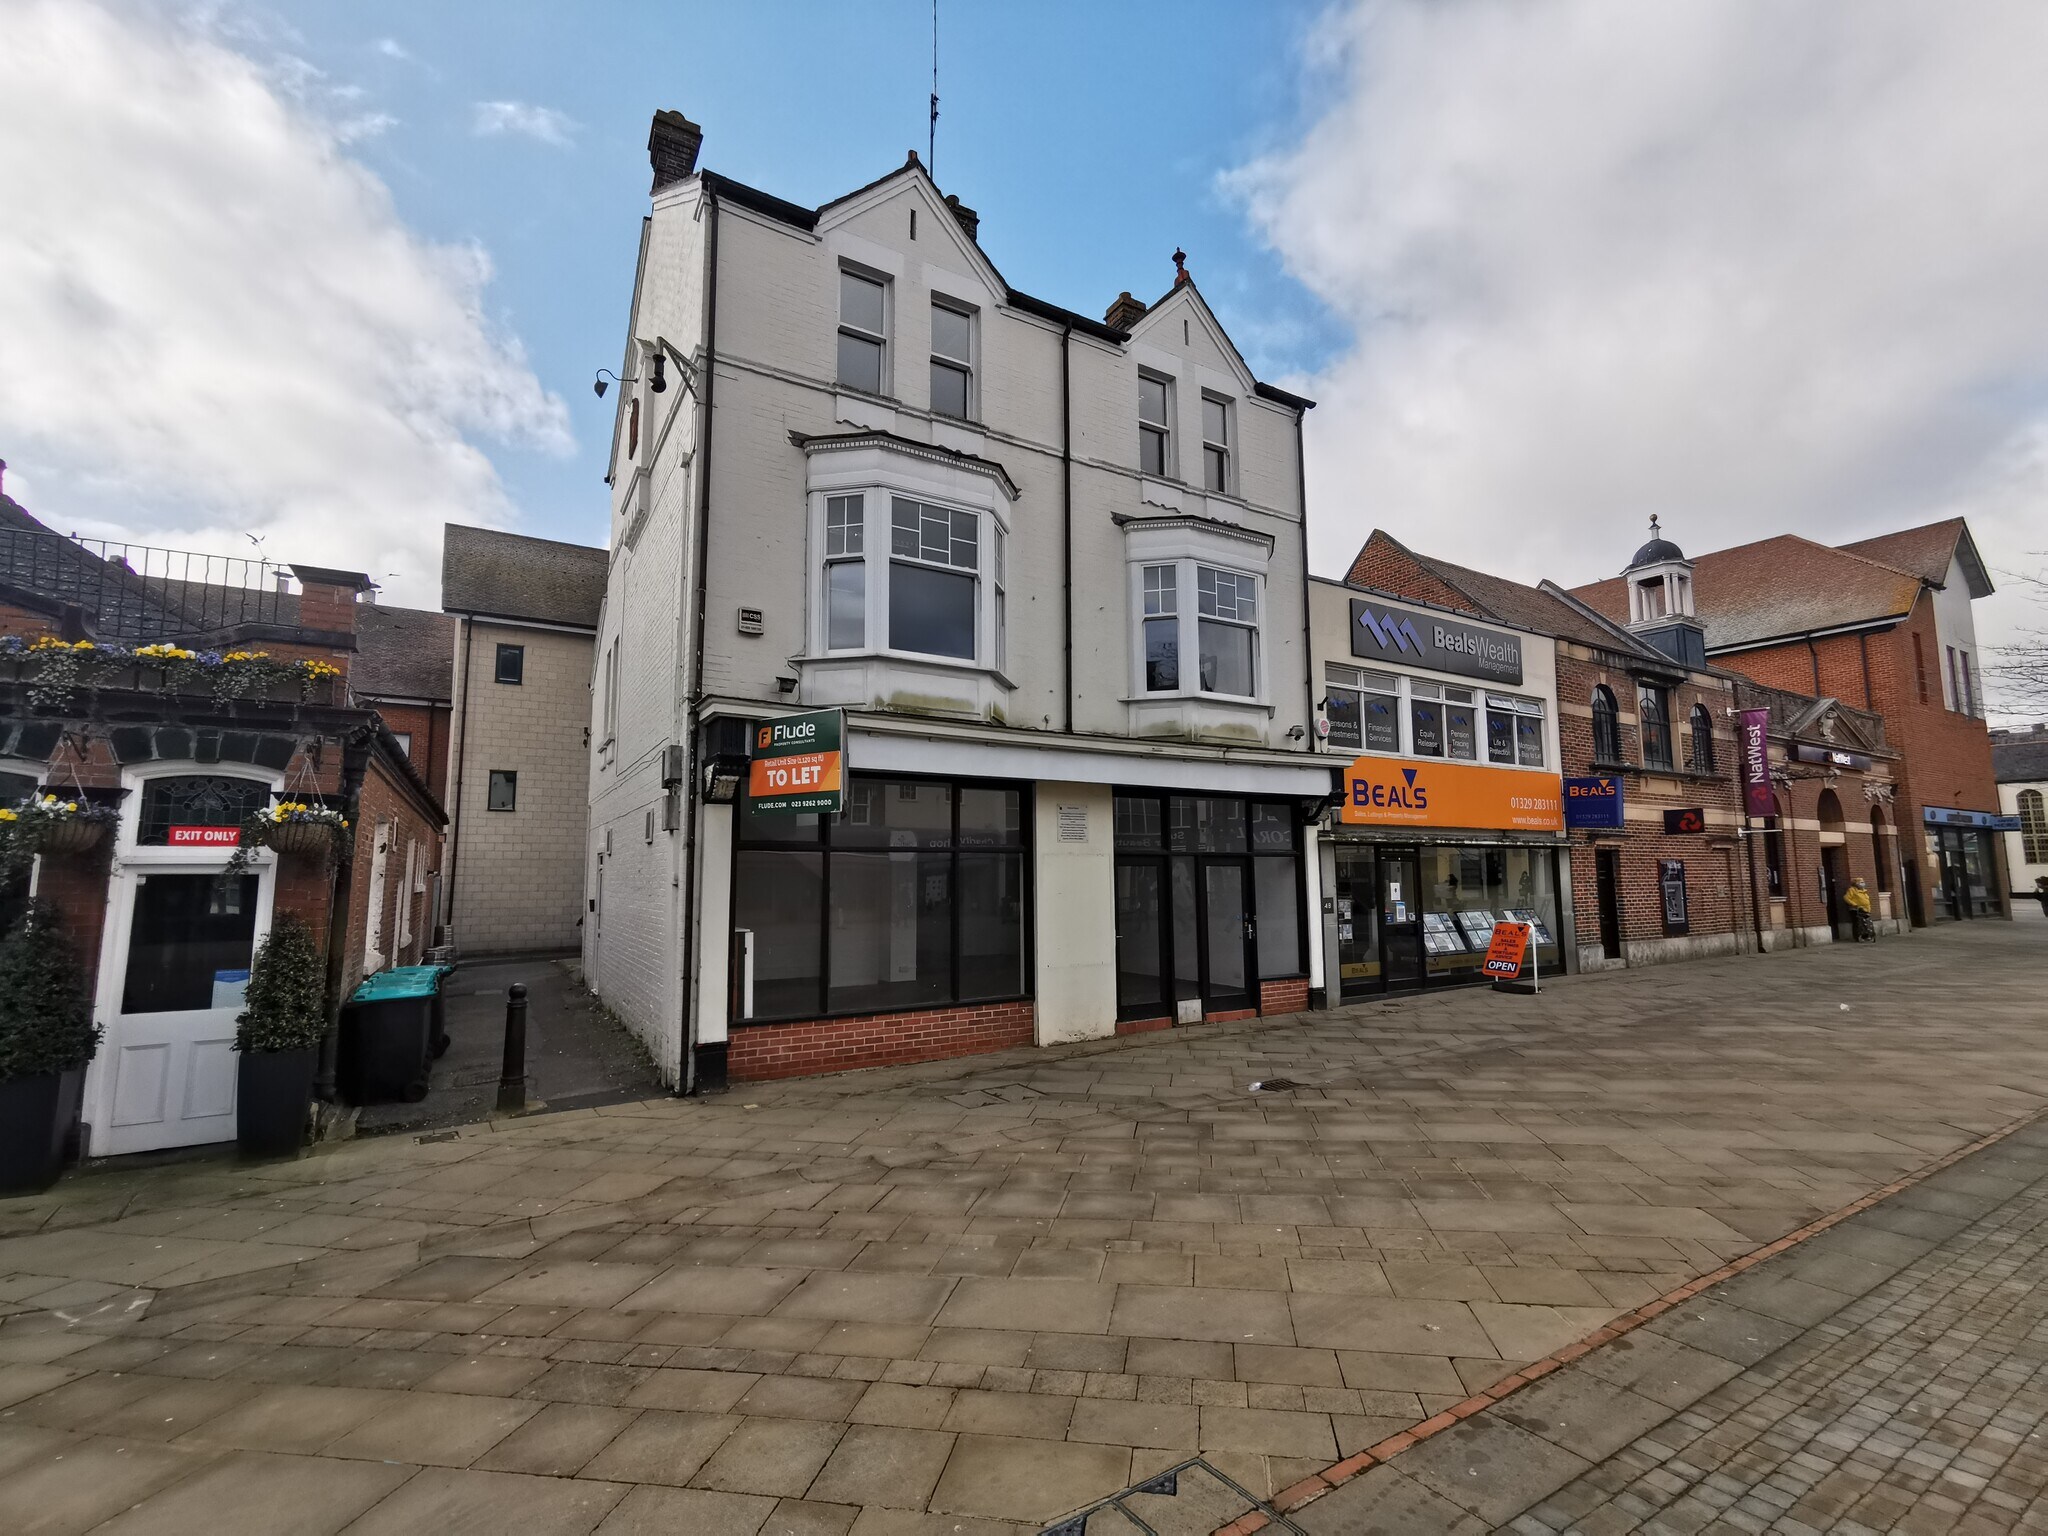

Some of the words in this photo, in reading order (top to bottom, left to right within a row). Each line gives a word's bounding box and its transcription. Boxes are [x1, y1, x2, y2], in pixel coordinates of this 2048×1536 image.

[1478, 658, 1519, 675] Management
[1330, 720, 1352, 729] ensions
[1353, 721, 1358, 729] &
[1368, 723, 1392, 733] Financial
[774, 722, 816, 740] Flude
[1328, 731, 1360, 740] nvestments
[1419, 729, 1435, 739] Equity
[1450, 729, 1469, 738] Pension
[1368, 733, 1392, 743] Services
[1501, 739, 1506, 747] &
[1417, 739, 1438, 748] Release
[1452, 740, 1469, 749] Tracing
[1452, 748, 1470, 757] Service
[1489, 747, 1511, 756] Protection
[1747, 724, 1765, 784] NatWest
[1832, 752, 1851, 765] NatWest
[767, 769, 788, 787] TO
[792, 766, 821, 785] LET
[1352, 779, 1427, 809] BEALS
[1570, 786, 1615, 797] BEALS
[1510, 797, 1532, 810] 01329
[1534, 798, 1558, 811] 283111
[1512, 816, 1558, 827] www.beals.co.uk
[175, 830, 202, 840] EXIT
[204, 831, 237, 841] ONLY
[1495, 929, 1527, 937] BEALS
[1488, 961, 1516, 972] OPEN
